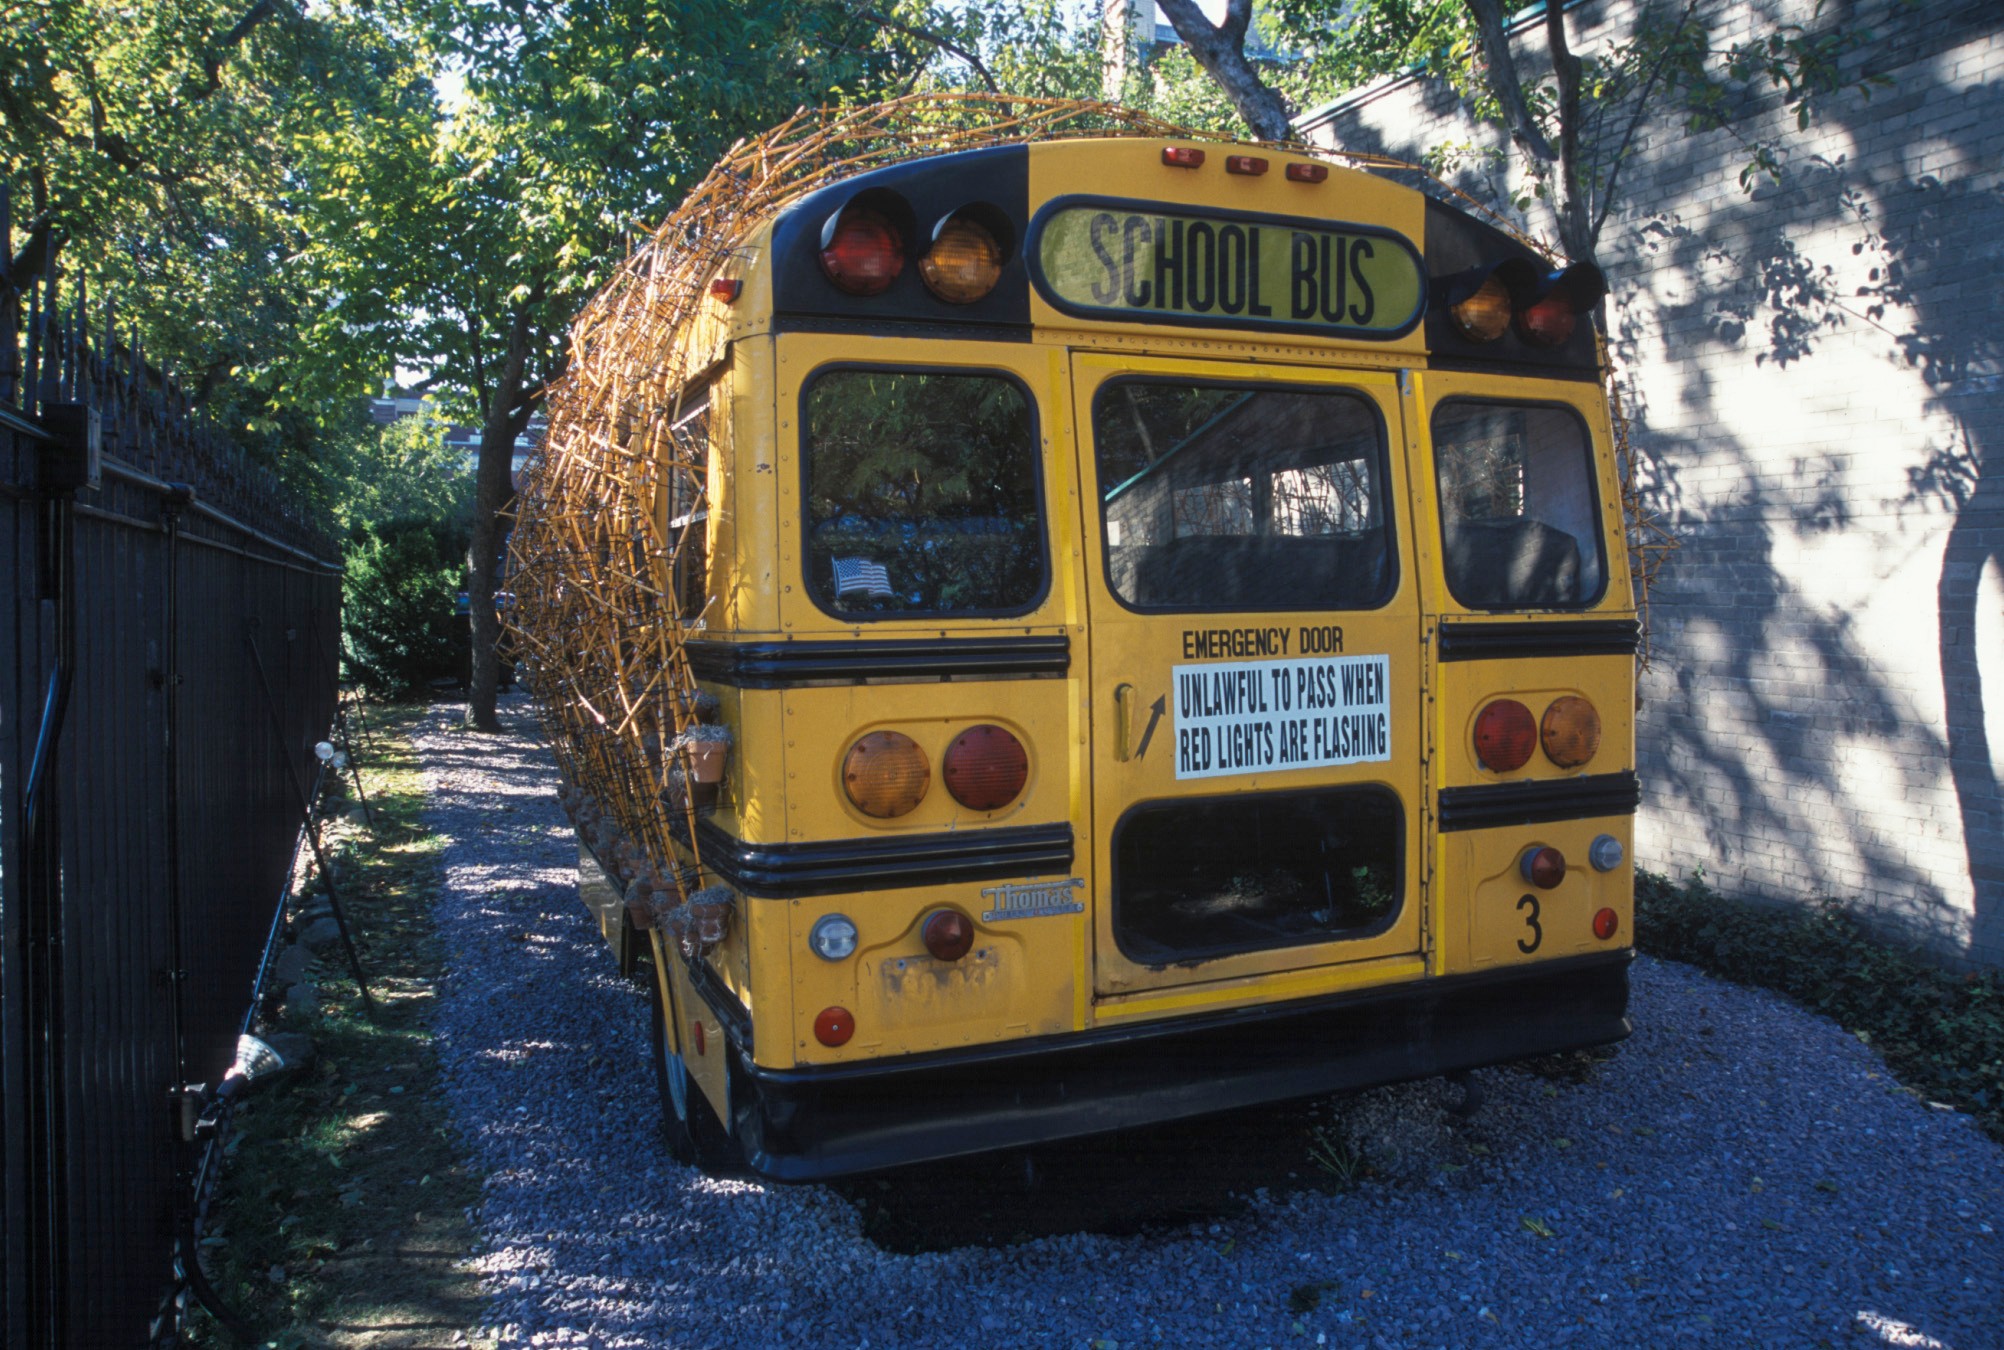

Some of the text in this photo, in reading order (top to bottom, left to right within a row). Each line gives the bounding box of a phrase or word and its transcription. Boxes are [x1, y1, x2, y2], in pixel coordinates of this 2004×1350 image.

[1089, 212, 1375, 326] SCHOOL BUS
[1182, 626, 1343, 659] EMERGENCY DOOR
[1180, 662, 1384, 719] UNLAWFUL TO PASS WHEN
[1180, 712, 1386, 773] RED LIGHTS ARE FLASHING
[982, 883, 1077, 912] Thomas
[1516, 893, 1542, 954] 3
